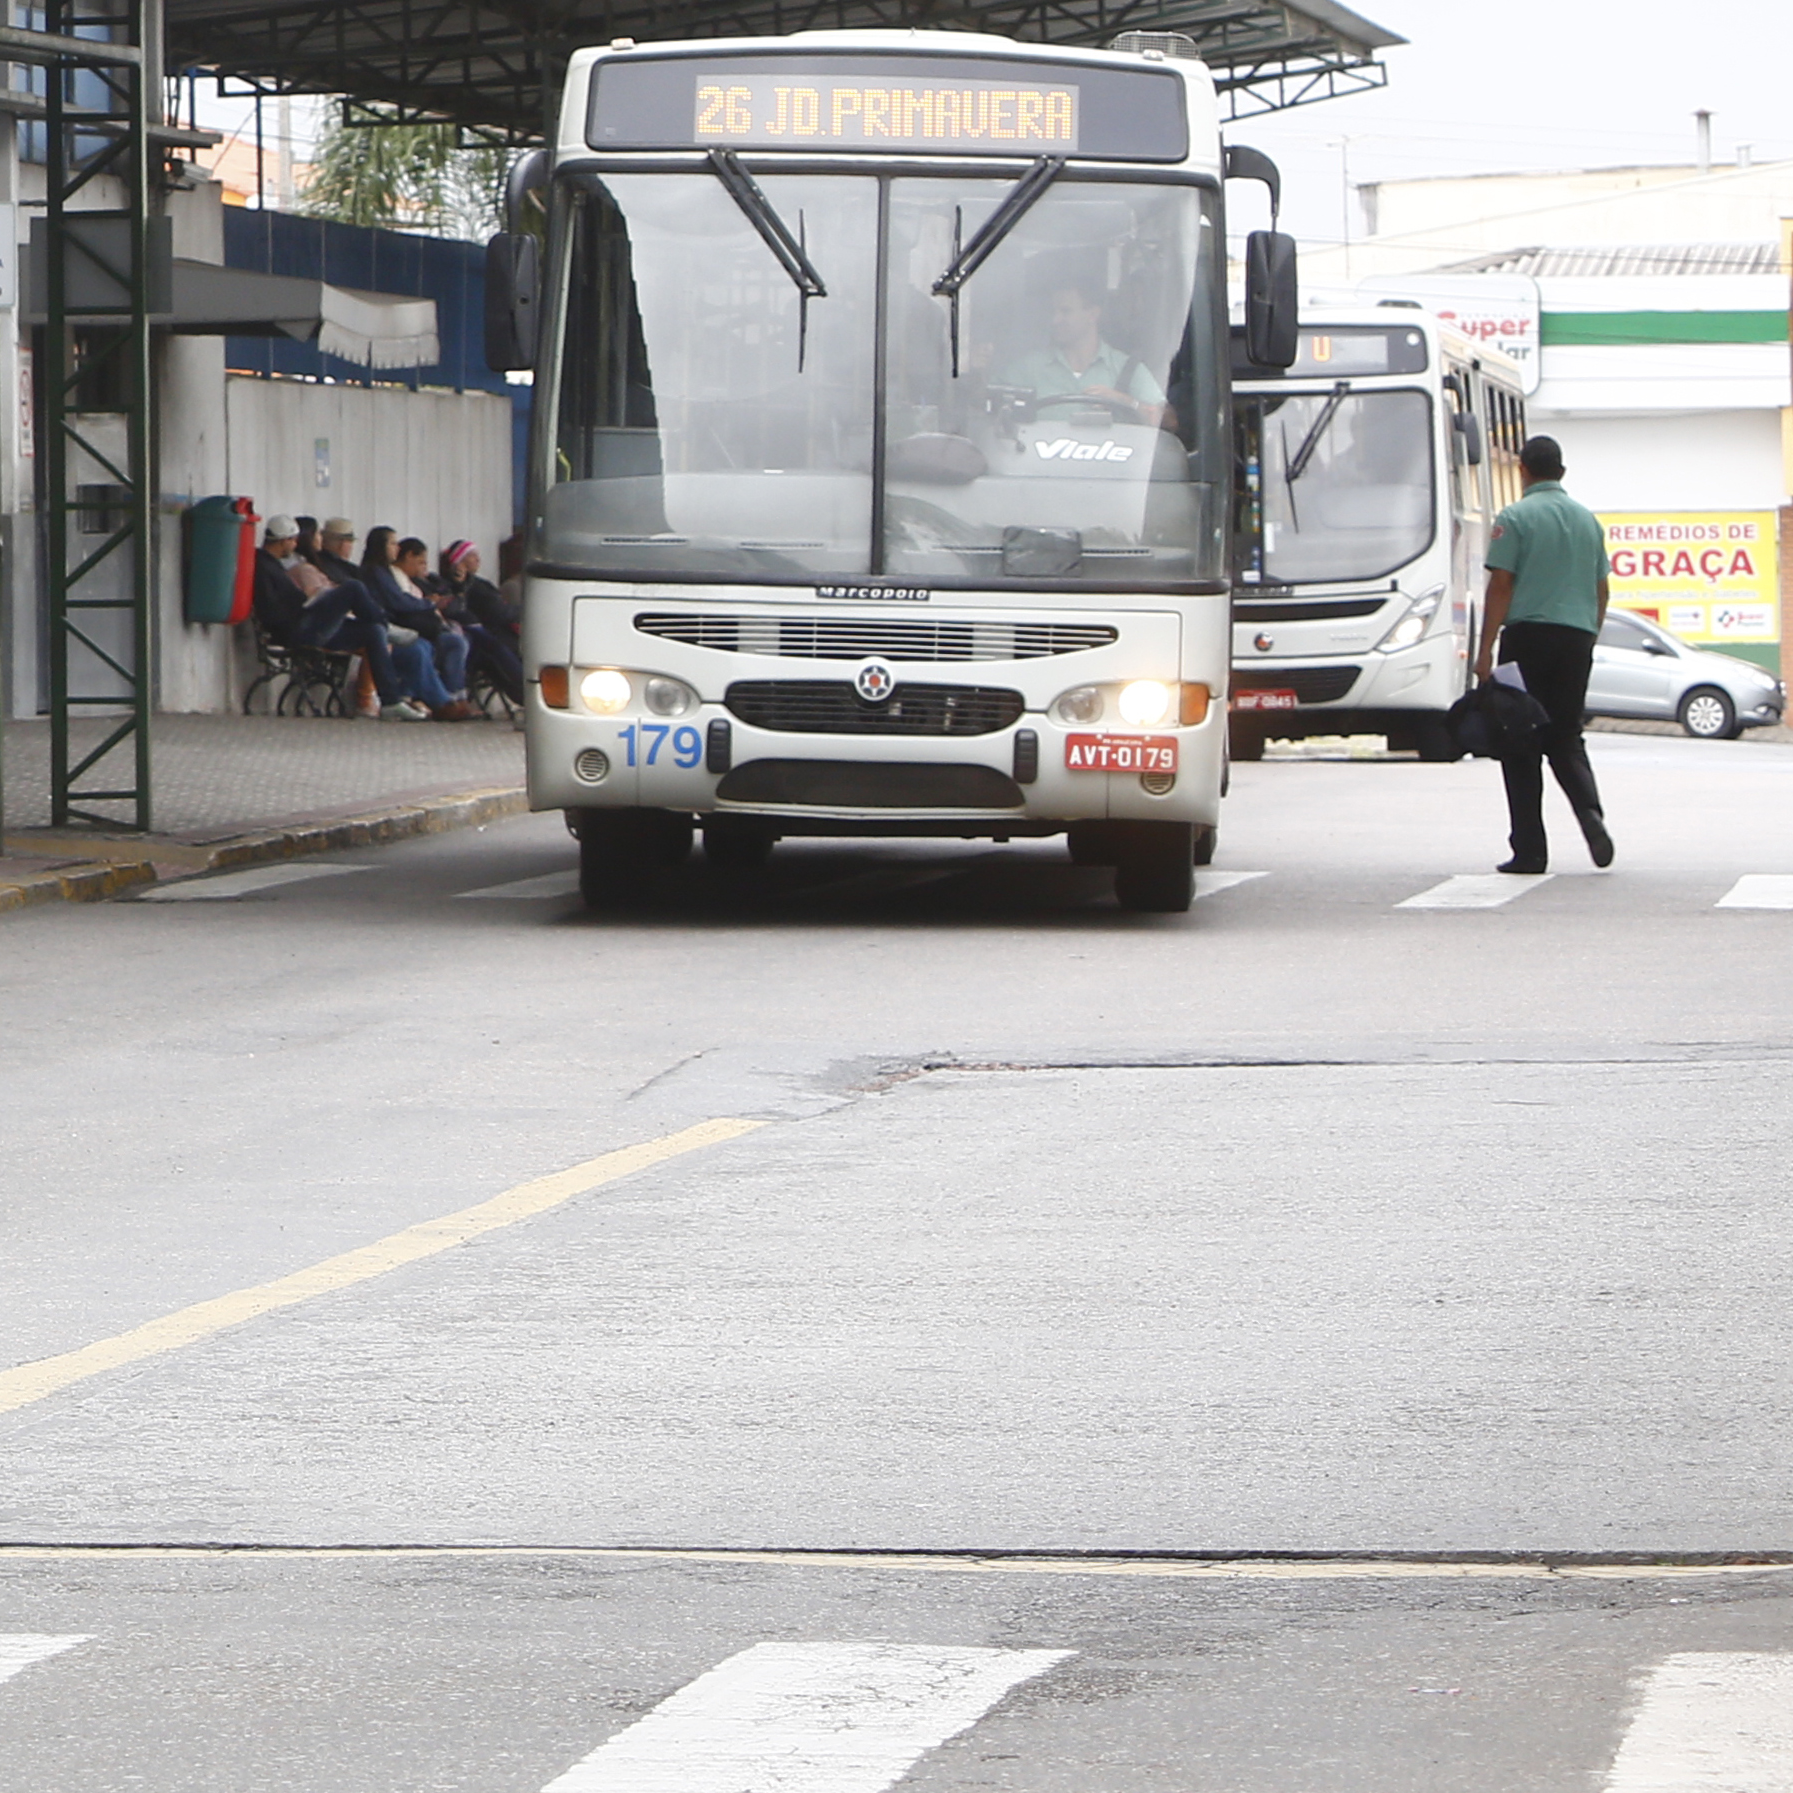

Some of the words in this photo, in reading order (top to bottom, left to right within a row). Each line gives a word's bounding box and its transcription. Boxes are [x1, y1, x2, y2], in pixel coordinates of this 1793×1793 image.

[697, 85, 753, 135] 26
[1034, 438, 1134, 463] Viale
[1609, 521, 1720, 541] REMÉDIOS
[1728, 524, 1756, 540] DE
[1610, 549, 1755, 584] GRAÇA
[818, 586, 928, 600] Marcopolo
[617, 724, 702, 768] 179
